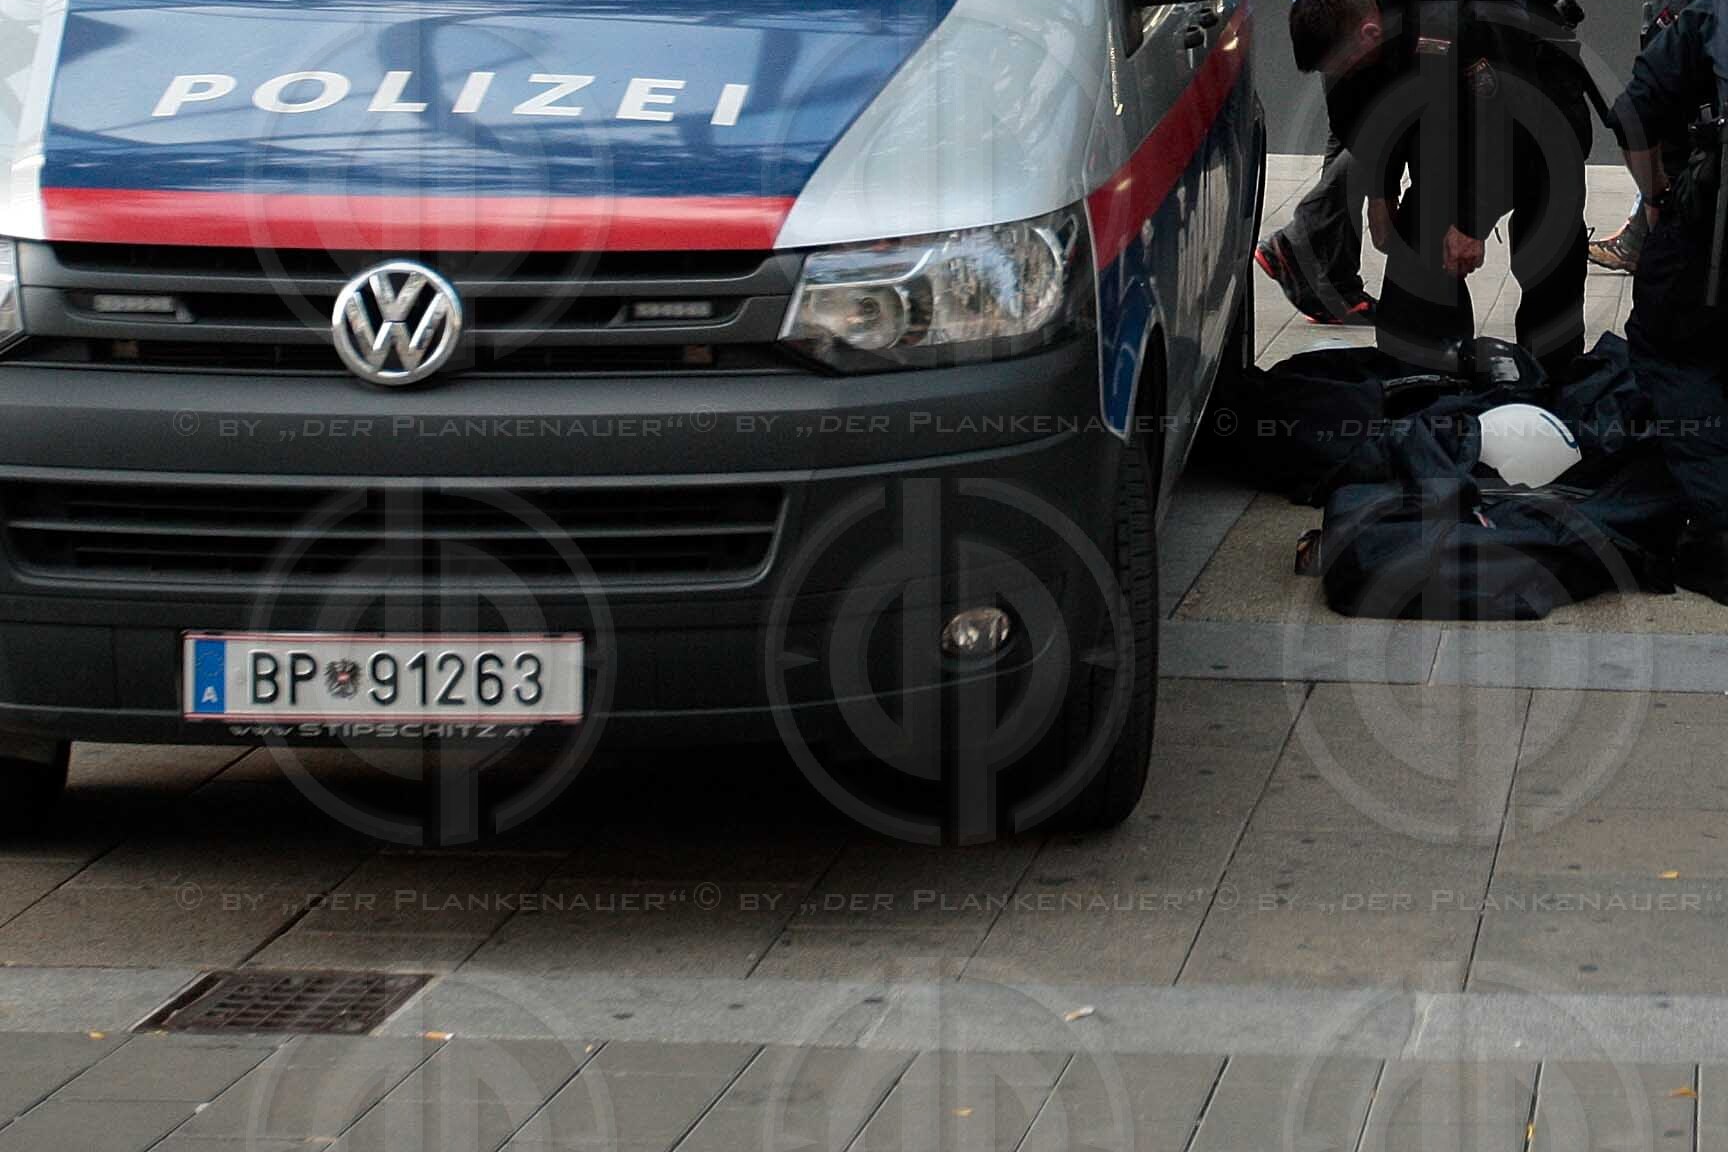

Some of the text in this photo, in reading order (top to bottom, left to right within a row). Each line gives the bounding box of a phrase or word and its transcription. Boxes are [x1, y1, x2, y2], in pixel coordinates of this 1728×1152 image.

[151, 70, 748, 126] POLIZEI
[201, 686, 218, 703] A
[248, 650, 544, 707] BP 91263
